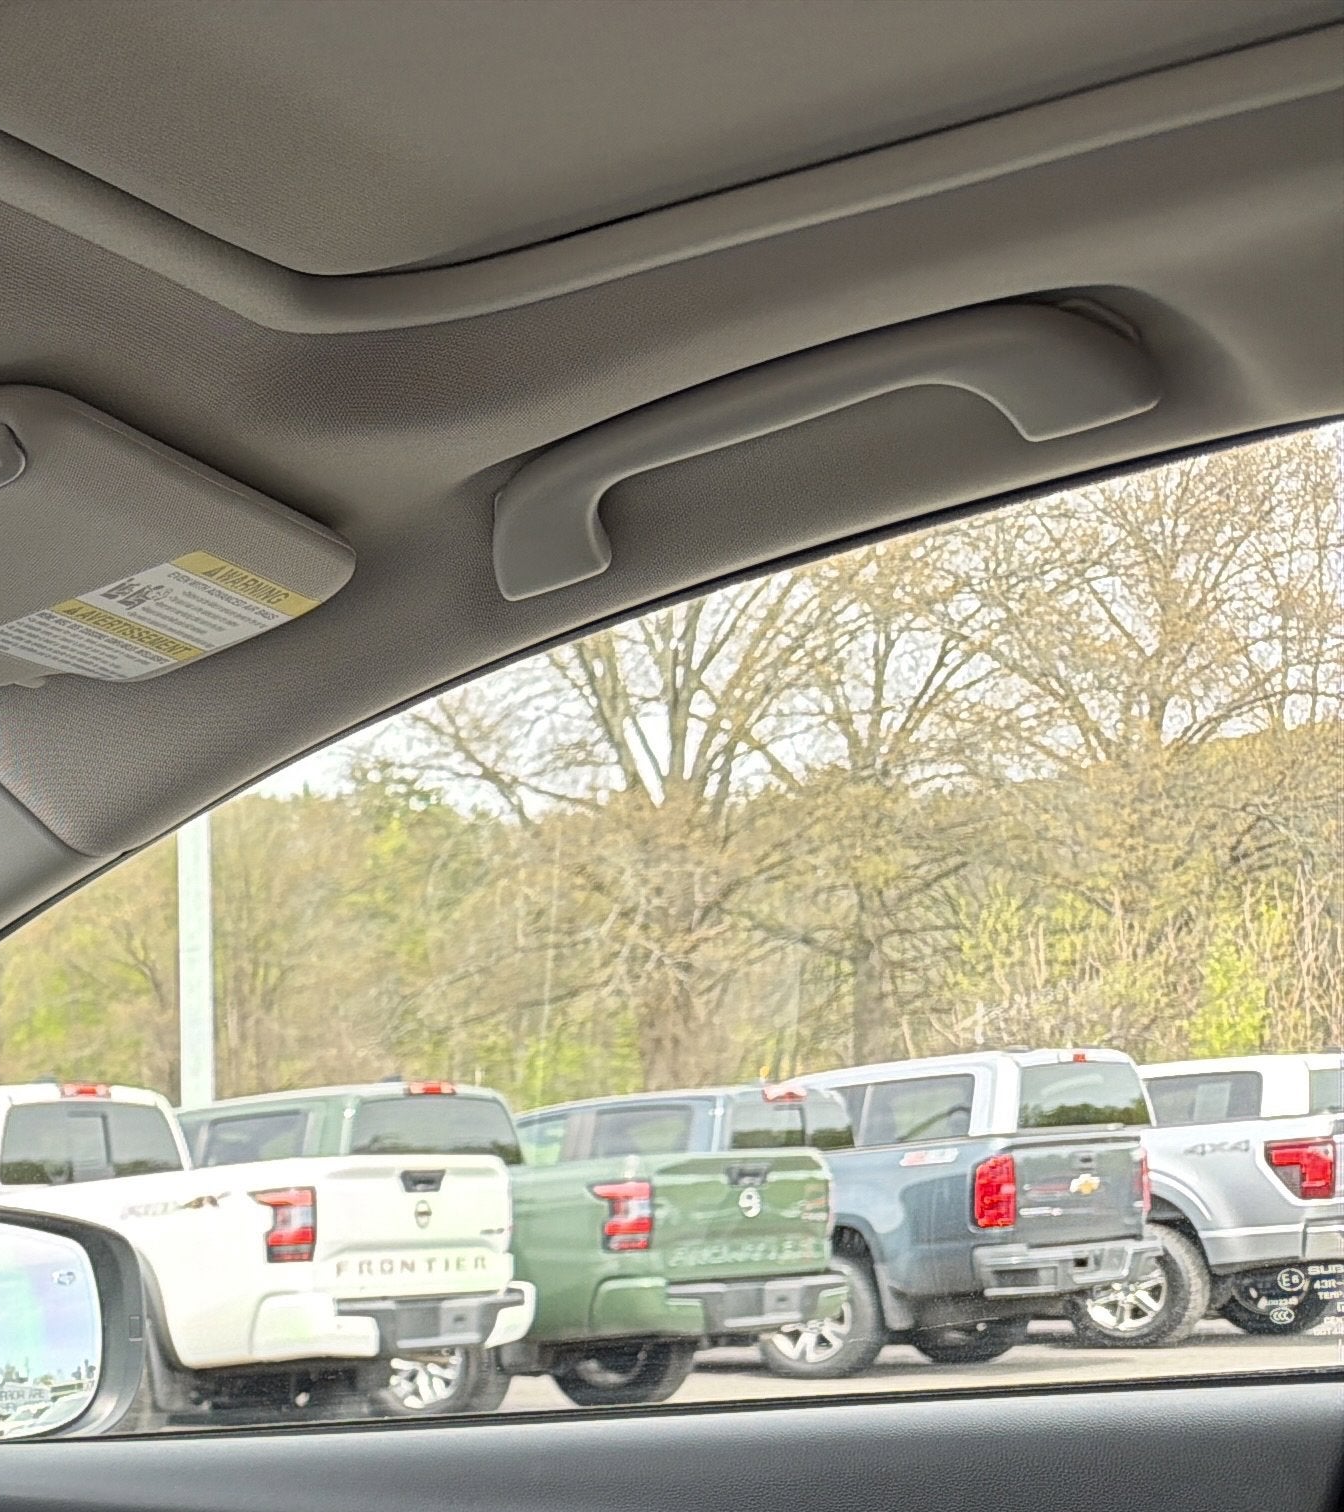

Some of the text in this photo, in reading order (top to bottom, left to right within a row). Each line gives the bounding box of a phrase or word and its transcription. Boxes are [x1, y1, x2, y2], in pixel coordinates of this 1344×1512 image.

[217, 569, 290, 606] WARNING
[79, 606, 193, 657] AVERTISSEMENT
[335, 1255, 488, 1279] FRONTIER
